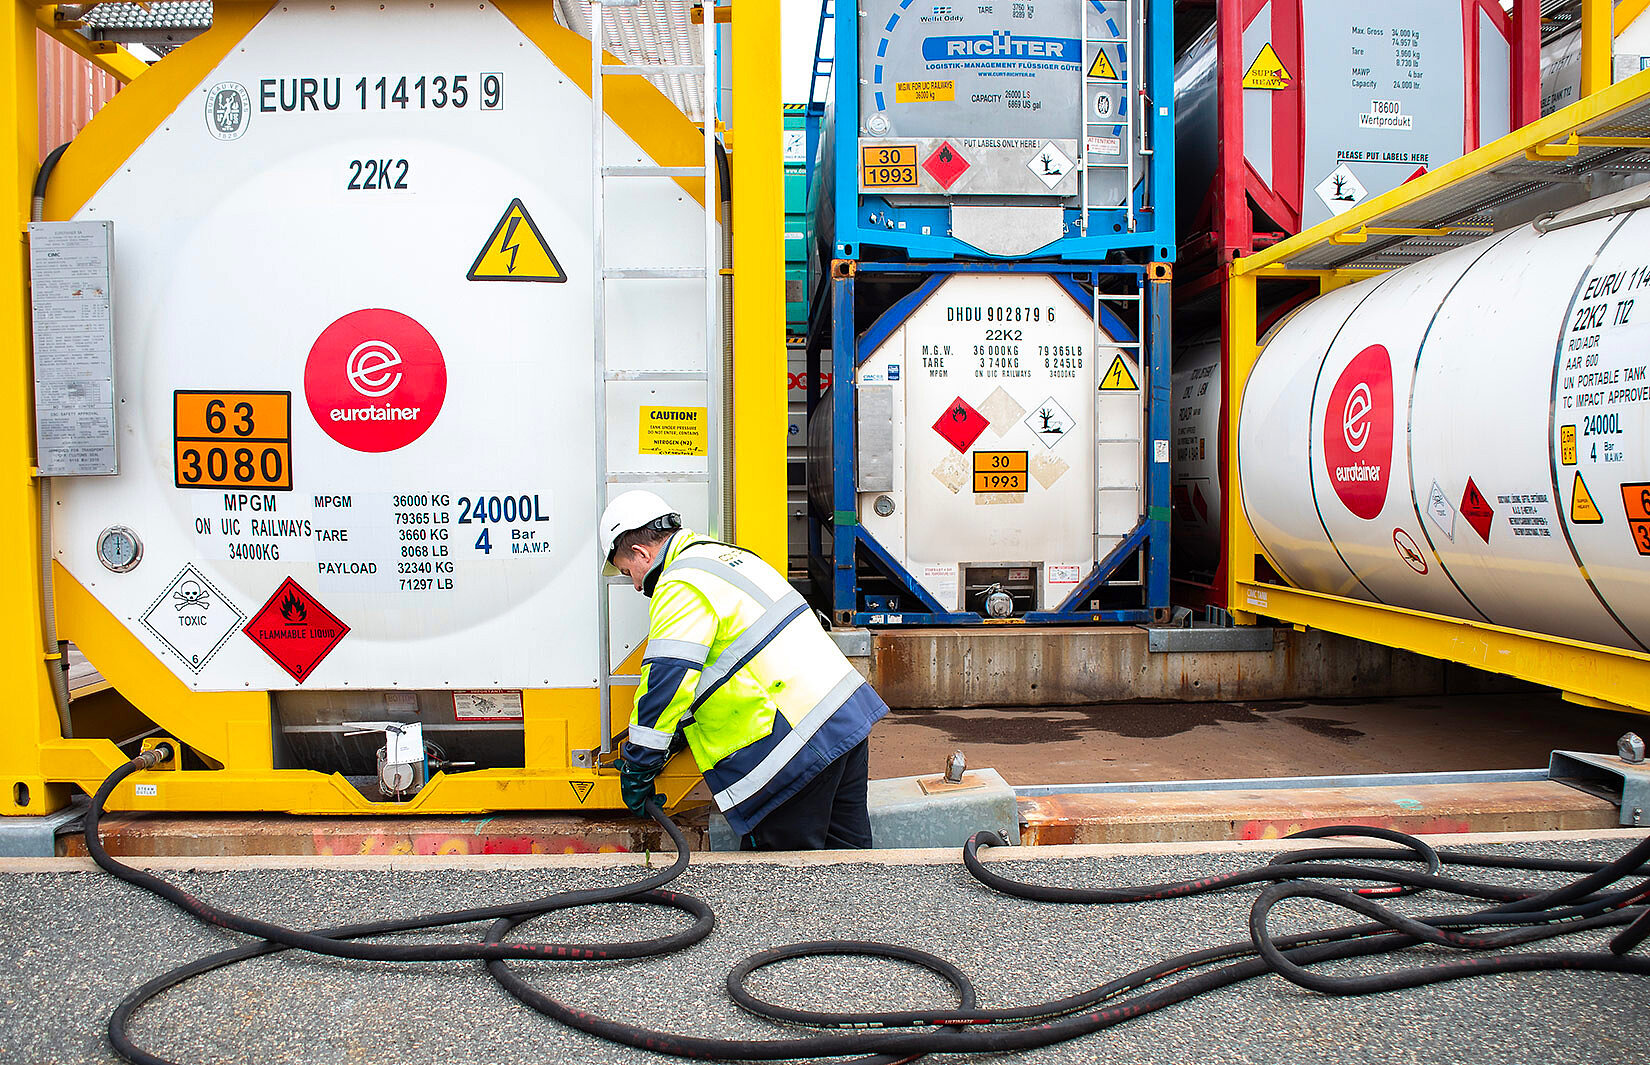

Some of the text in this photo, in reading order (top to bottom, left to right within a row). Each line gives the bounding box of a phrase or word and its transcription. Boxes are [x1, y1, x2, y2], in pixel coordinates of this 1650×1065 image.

[1366, 27, 1384, 35] Gross
[1412, 30, 1420, 39] kg
[947, 30, 1064, 58] RICHTER
[1352, 47, 1420, 59] Tare kg
[925, 62, 1016, 72] LOGISTIK-MANAGEMENT
[1018, 61, 1058, 70] FLÜSSIGER
[1352, 79, 1377, 89] Capacity
[260, 75, 500, 112] EURU 114135 9
[971, 94, 1002, 102] CAPACITY
[1022, 100, 1032, 108] US
[1032, 101, 1041, 110] gal
[1372, 101, 1400, 114] T8600
[1360, 114, 1411, 127] Wertprodukt
[964, 140, 1036, 148] PUT LABELS ONLY HERE
[879, 150, 900, 164] 30
[1337, 150, 1429, 162] PLEASE PUT LABELS HERE
[348, 159, 409, 190] 22K2
[869, 168, 912, 183] 1993
[1583, 265, 1650, 301] EURU 114
[947, 306, 1055, 322] DHDU 902879 6
[1572, 303, 1608, 332] 22K2
[985, 329, 1023, 341] 22K2
[922, 345, 1082, 356] M.G.W. 36 000KG 79 365LB
[922, 358, 944, 368] TARE
[989, 358, 1019, 368] 740KG
[1053, 358, 1082, 368] 245LB
[1566, 354, 1599, 371] AAR 600
[1564, 366, 1647, 390] UN PORTABLE TANK
[1563, 386, 1650, 409] TC IMPACT APPROVE
[206, 400, 255, 436] 63
[330, 403, 420, 422] eurotainer
[650, 410, 697, 421] CAUTION!
[1584, 413, 1623, 436] 24000L
[1591, 442, 1614, 463] 4 Bar
[182, 448, 282, 482] 3080
[992, 456, 1010, 468] 30
[1336, 460, 1380, 482] eurotainer
[984, 476, 1018, 488] 1993
[224, 494, 276, 512] MPGM
[314, 494, 450, 508] MPGM 36000 KG
[457, 495, 550, 524] 24000L
[395, 512, 450, 524] 79365 LB
[195, 518, 312, 537] ON UIC RAILWAYS
[315, 528, 449, 542] TARE 3660 KG
[474, 528, 536, 554] 4 Bar
[1638, 525, 1650, 550] 3
[229, 543, 280, 560] 34000KG
[401, 545, 449, 557] 8068 LB
[512, 542, 551, 554] M.A.W.P.
[318, 562, 454, 574] PAYLOAD 32340 KG
[399, 578, 454, 590] 71297 LB
[178, 616, 207, 627] TOXIC
[259, 628, 335, 640] FLAMMABLE LIQUID
[192, 654, 199, 664] 6
[296, 664, 303, 674] 3
